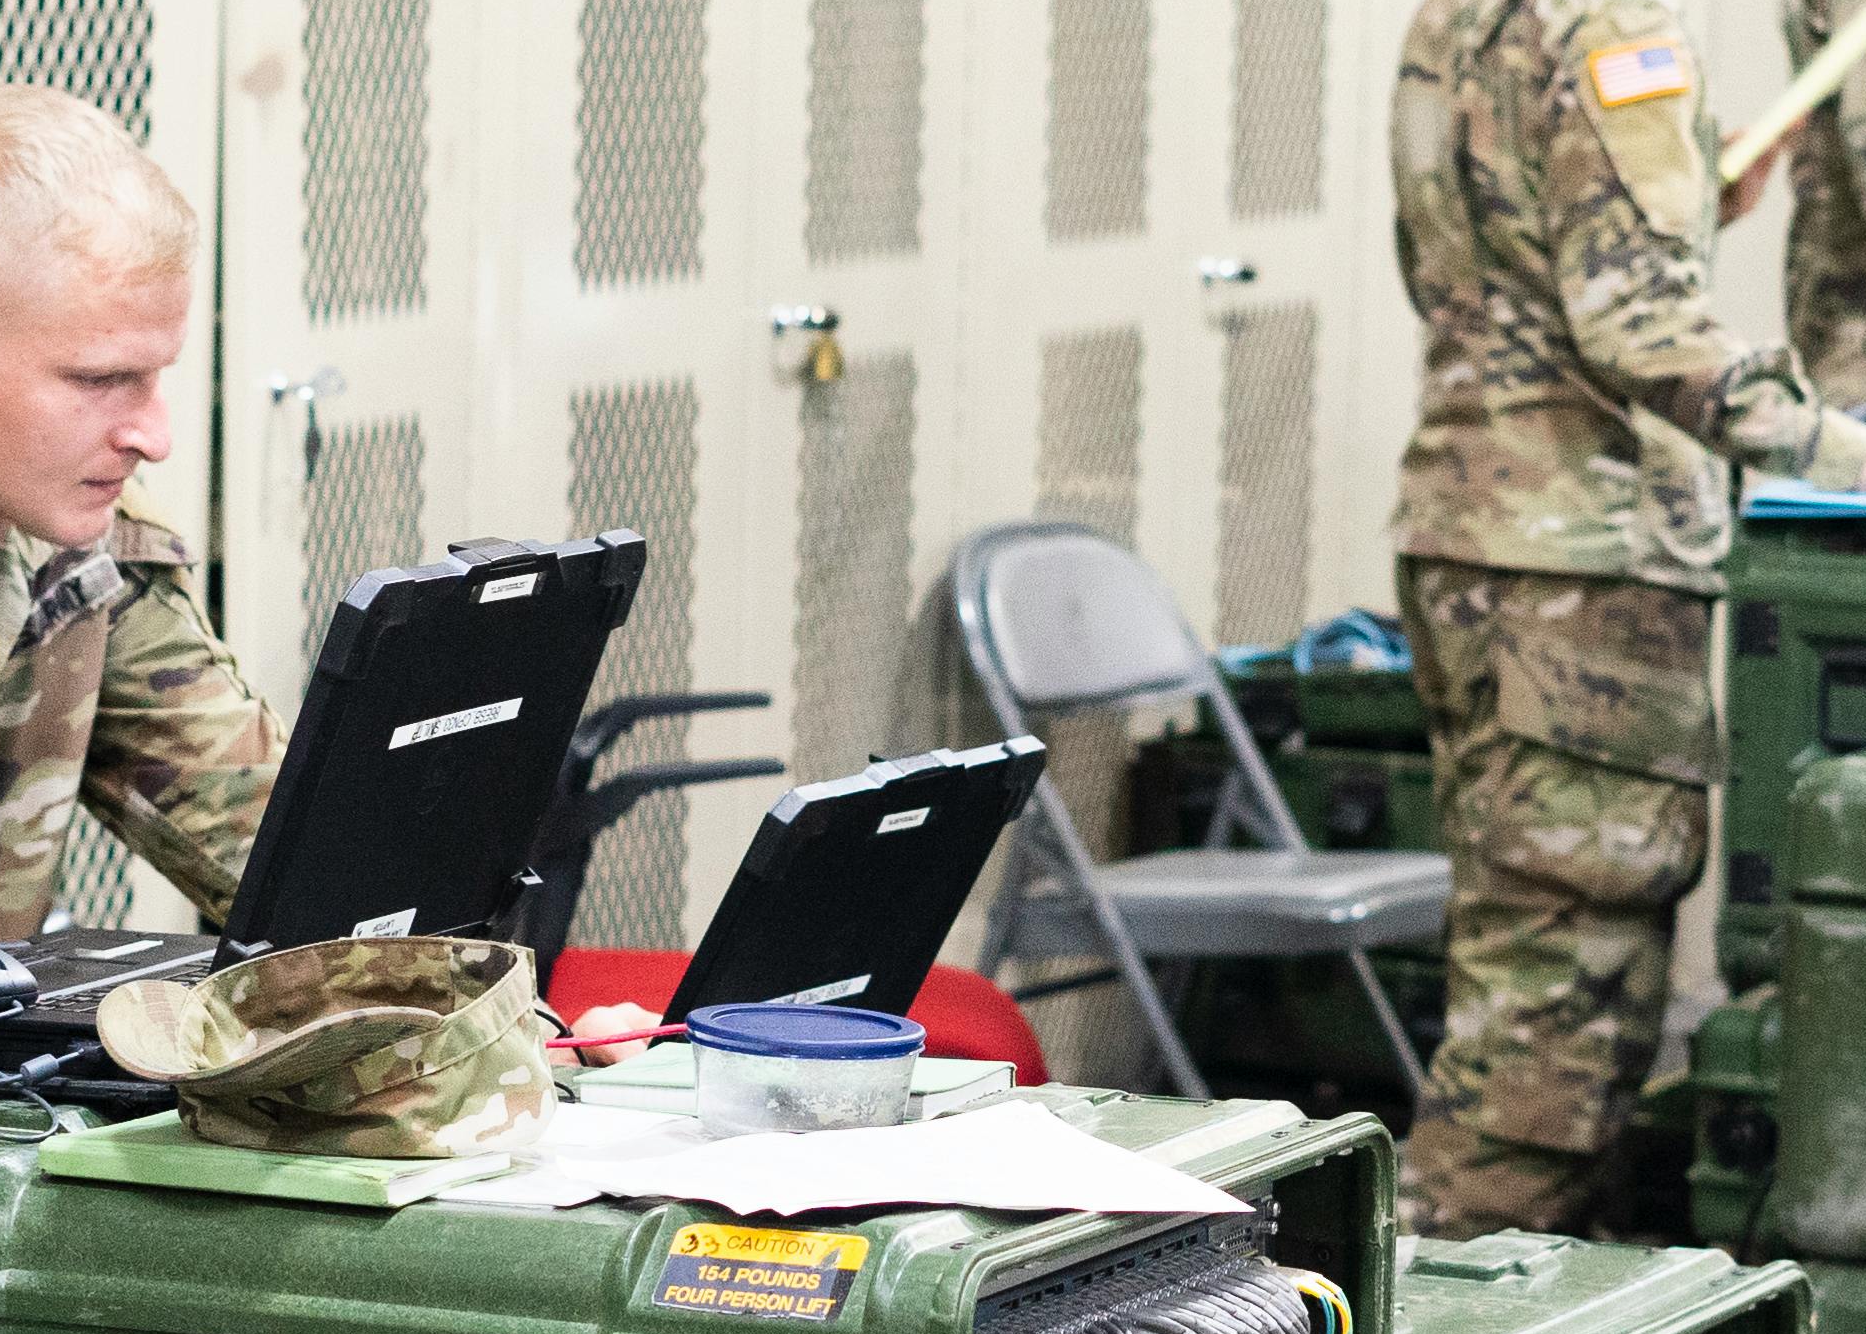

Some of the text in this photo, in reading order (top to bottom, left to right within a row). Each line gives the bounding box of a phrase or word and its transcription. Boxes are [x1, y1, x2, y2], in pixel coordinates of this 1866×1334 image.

[726, 1235, 815, 1255] CAUTION
[698, 1265, 821, 1289] 154 POUNDS
[664, 1285, 836, 1315] FOUR PERSON LIFT
